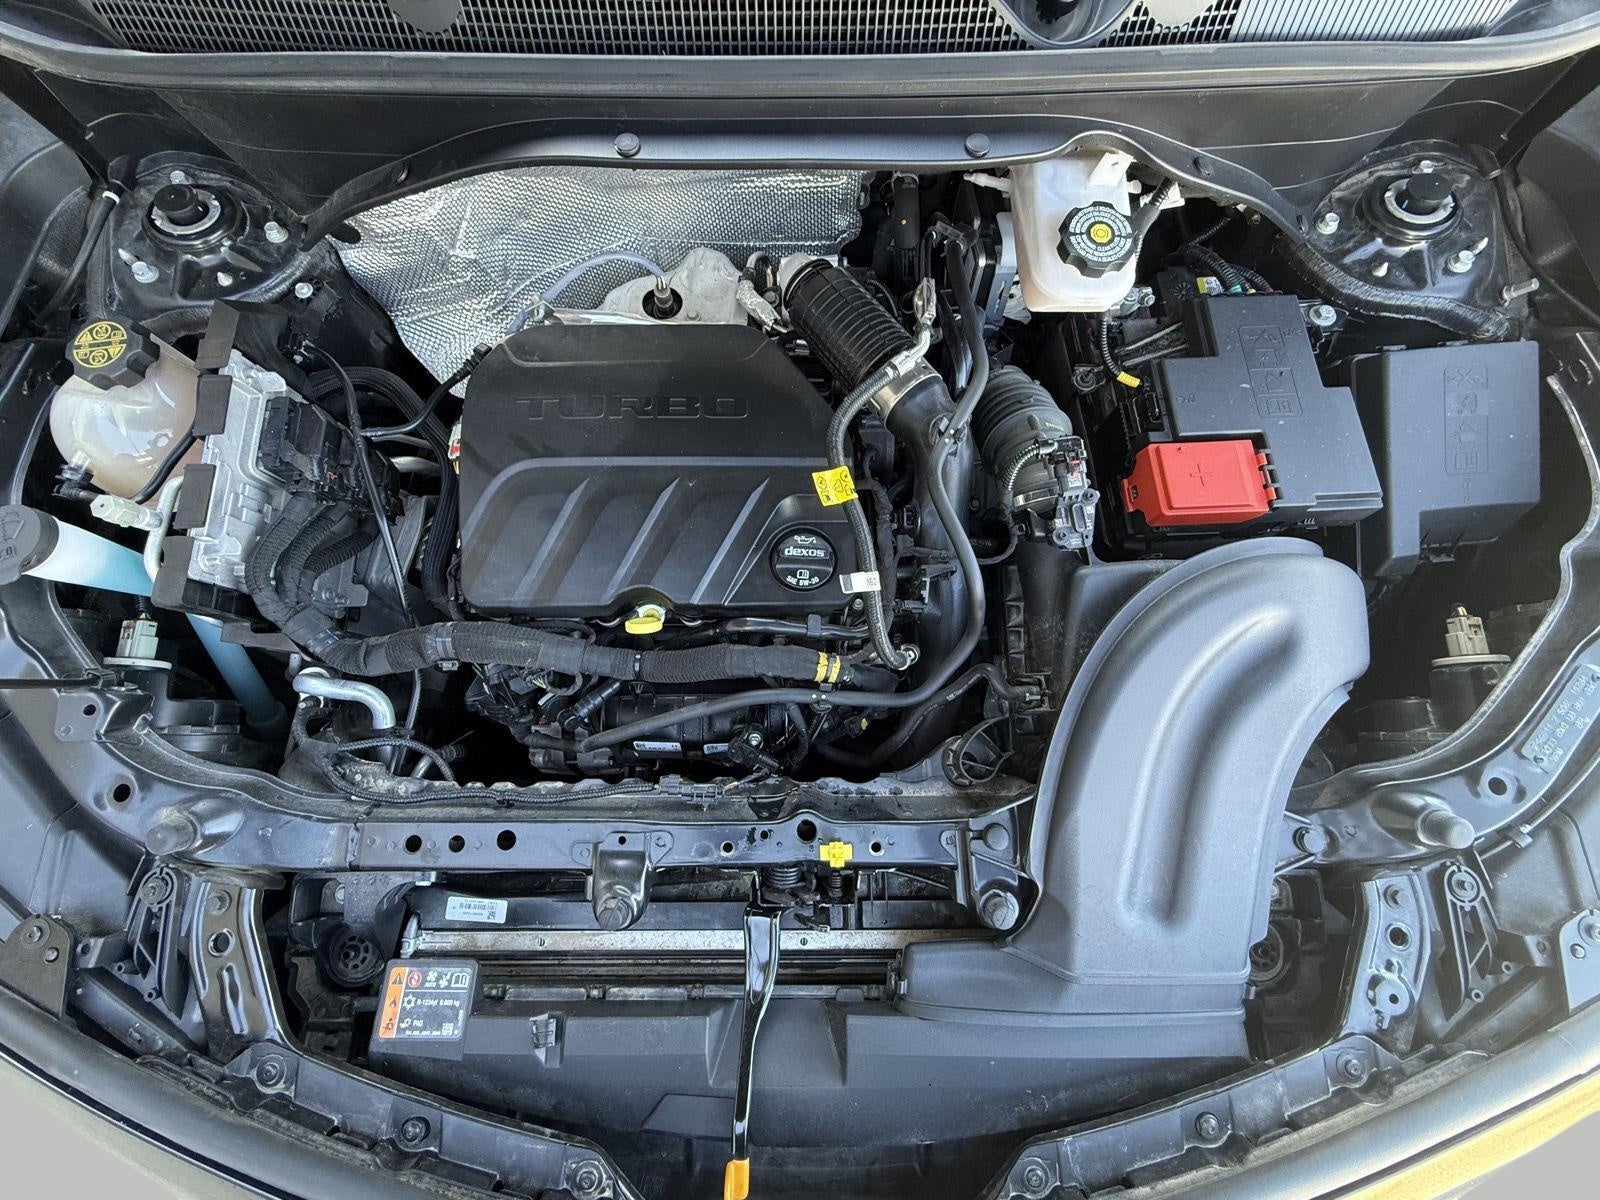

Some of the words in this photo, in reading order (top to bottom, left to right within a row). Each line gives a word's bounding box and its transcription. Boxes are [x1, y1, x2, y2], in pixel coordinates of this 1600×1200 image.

[516, 395, 748, 420] TURBO
[784, 546, 825, 557] dexos
[786, 575, 798, 585] SAE
